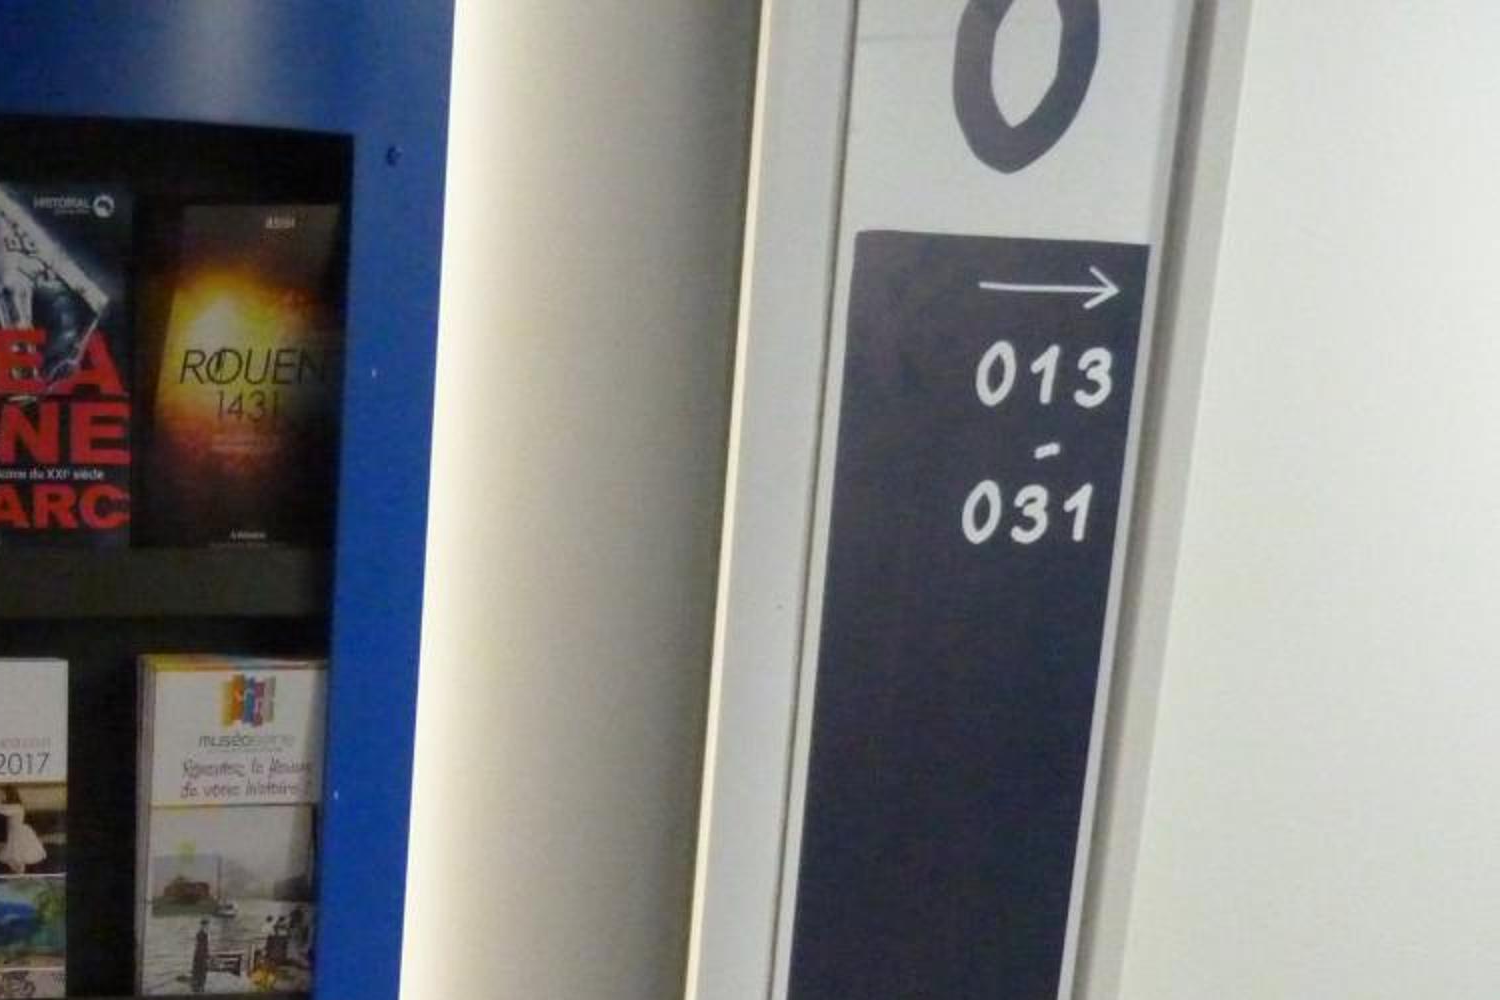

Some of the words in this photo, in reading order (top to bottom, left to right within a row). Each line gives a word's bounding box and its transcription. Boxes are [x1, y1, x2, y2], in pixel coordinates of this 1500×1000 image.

[952, 0, 1100, 174] 0
[179, 348, 326, 386] ROUEN
[975, 340, 1114, 409] 013
[217, 390, 278, 422] 1431
[961, 480, 1094, 545] 031
